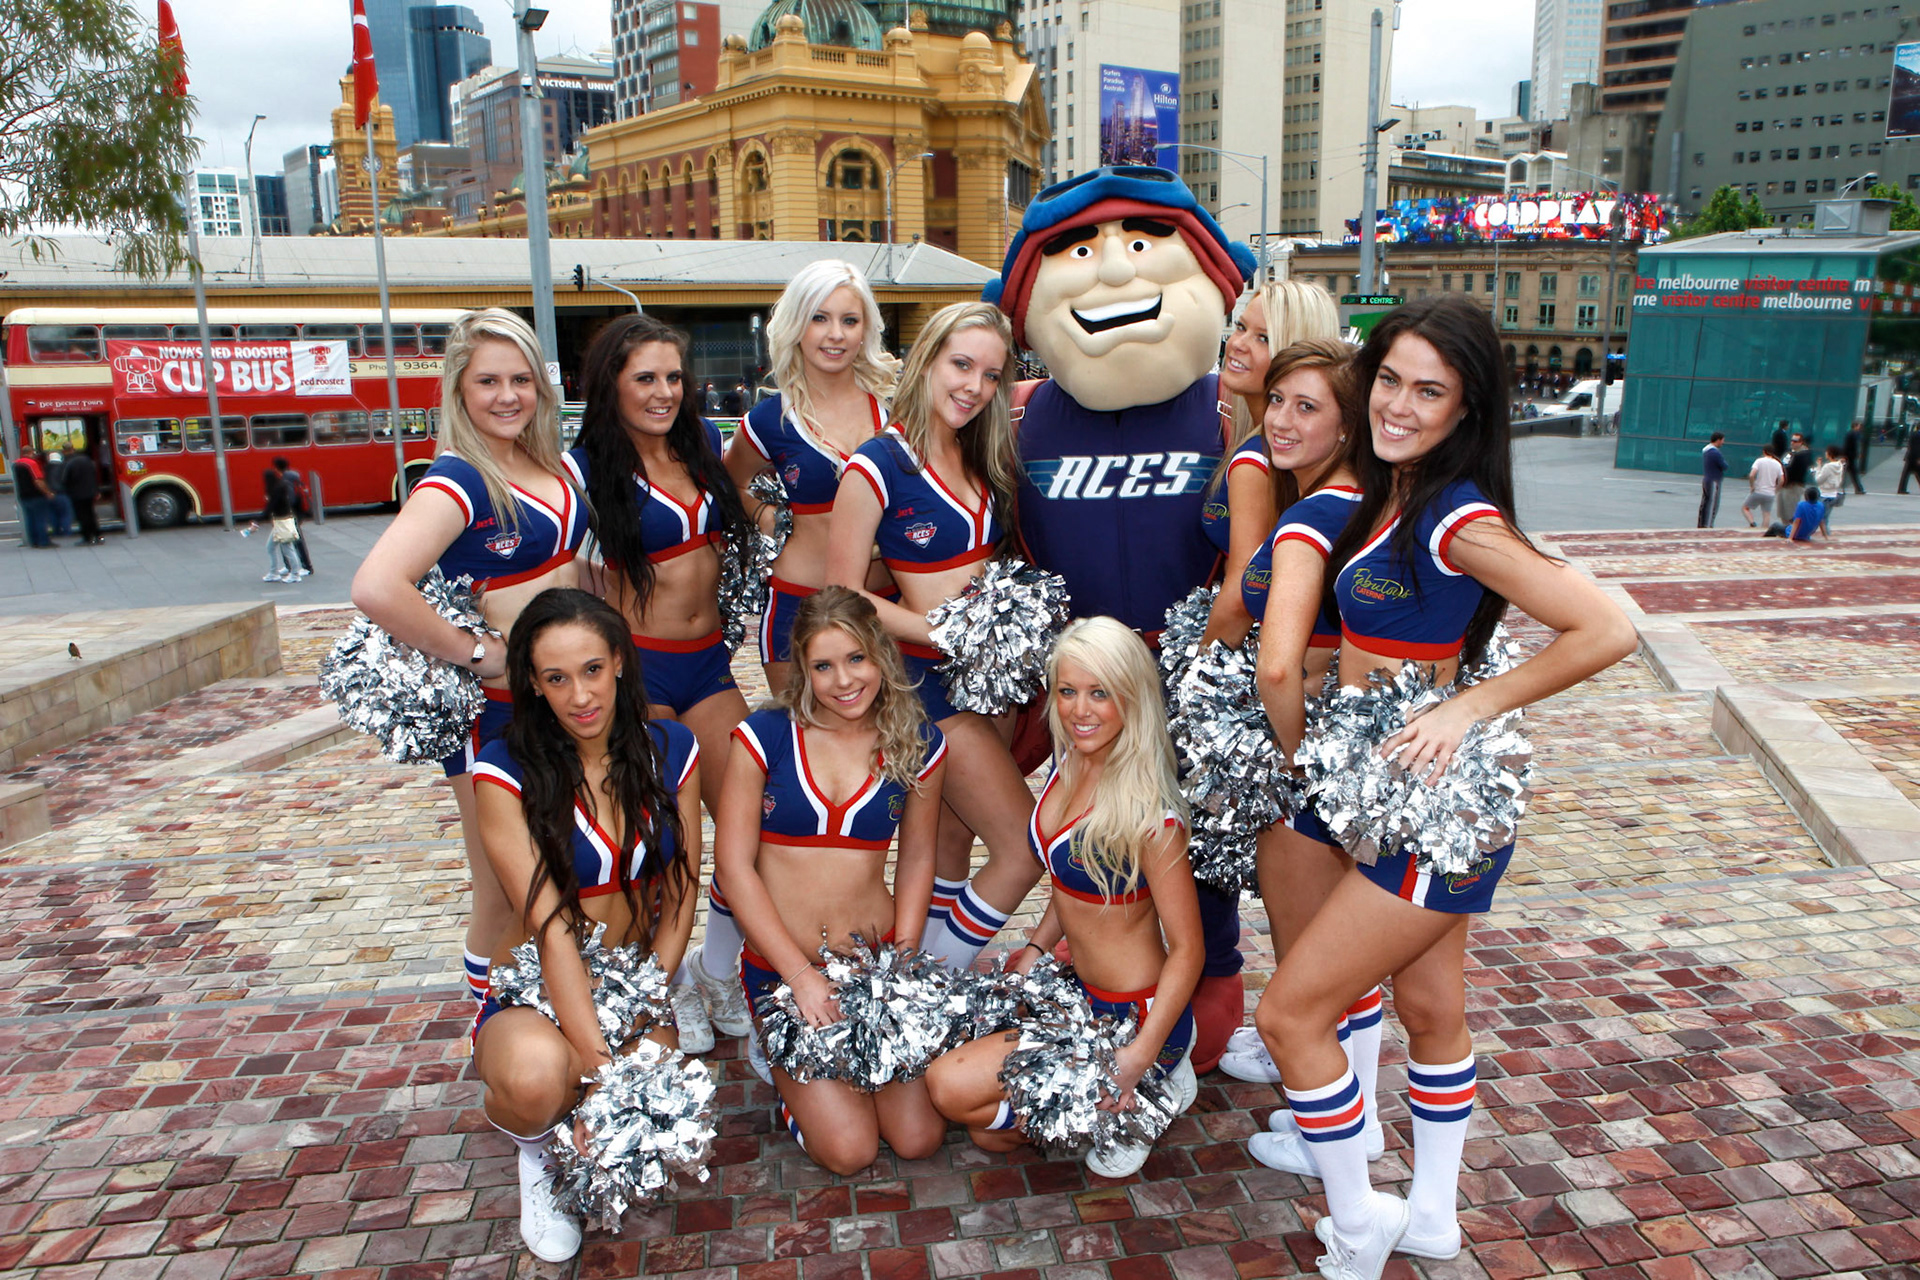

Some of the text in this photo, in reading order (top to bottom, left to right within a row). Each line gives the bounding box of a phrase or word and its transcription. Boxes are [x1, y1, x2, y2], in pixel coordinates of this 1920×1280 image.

[1103, 69, 1121, 77] Surfers
[539, 79, 615, 92] VICTORIA UNIVE
[1103, 77, 1125, 86] Paradise,
[1103, 85, 1125, 93] Australia
[1154, 94, 1178, 106] Hilton
[1474, 200, 1617, 227] COLDPLAY
[1344, 235, 1360, 243] APN
[1658, 274, 1739, 291] melbourne
[1745, 275, 1793, 292] visitor
[1798, 277, 1849, 292] centre
[1854, 279, 1871, 292] m
[1633, 291, 1870, 310] rne visitor centre melbourne v
[158, 346, 203, 359] NOVA'S
[235, 346, 288, 359] ROOSTER
[162, 360, 291, 393] CUP BUS
[300, 377, 345, 386] red rooster
[1047, 452, 1200, 499] ACES
[912, 529, 930, 539] ACES
[495, 539, 515, 550] ACES
[1355, 586, 1385, 600] CATERING
